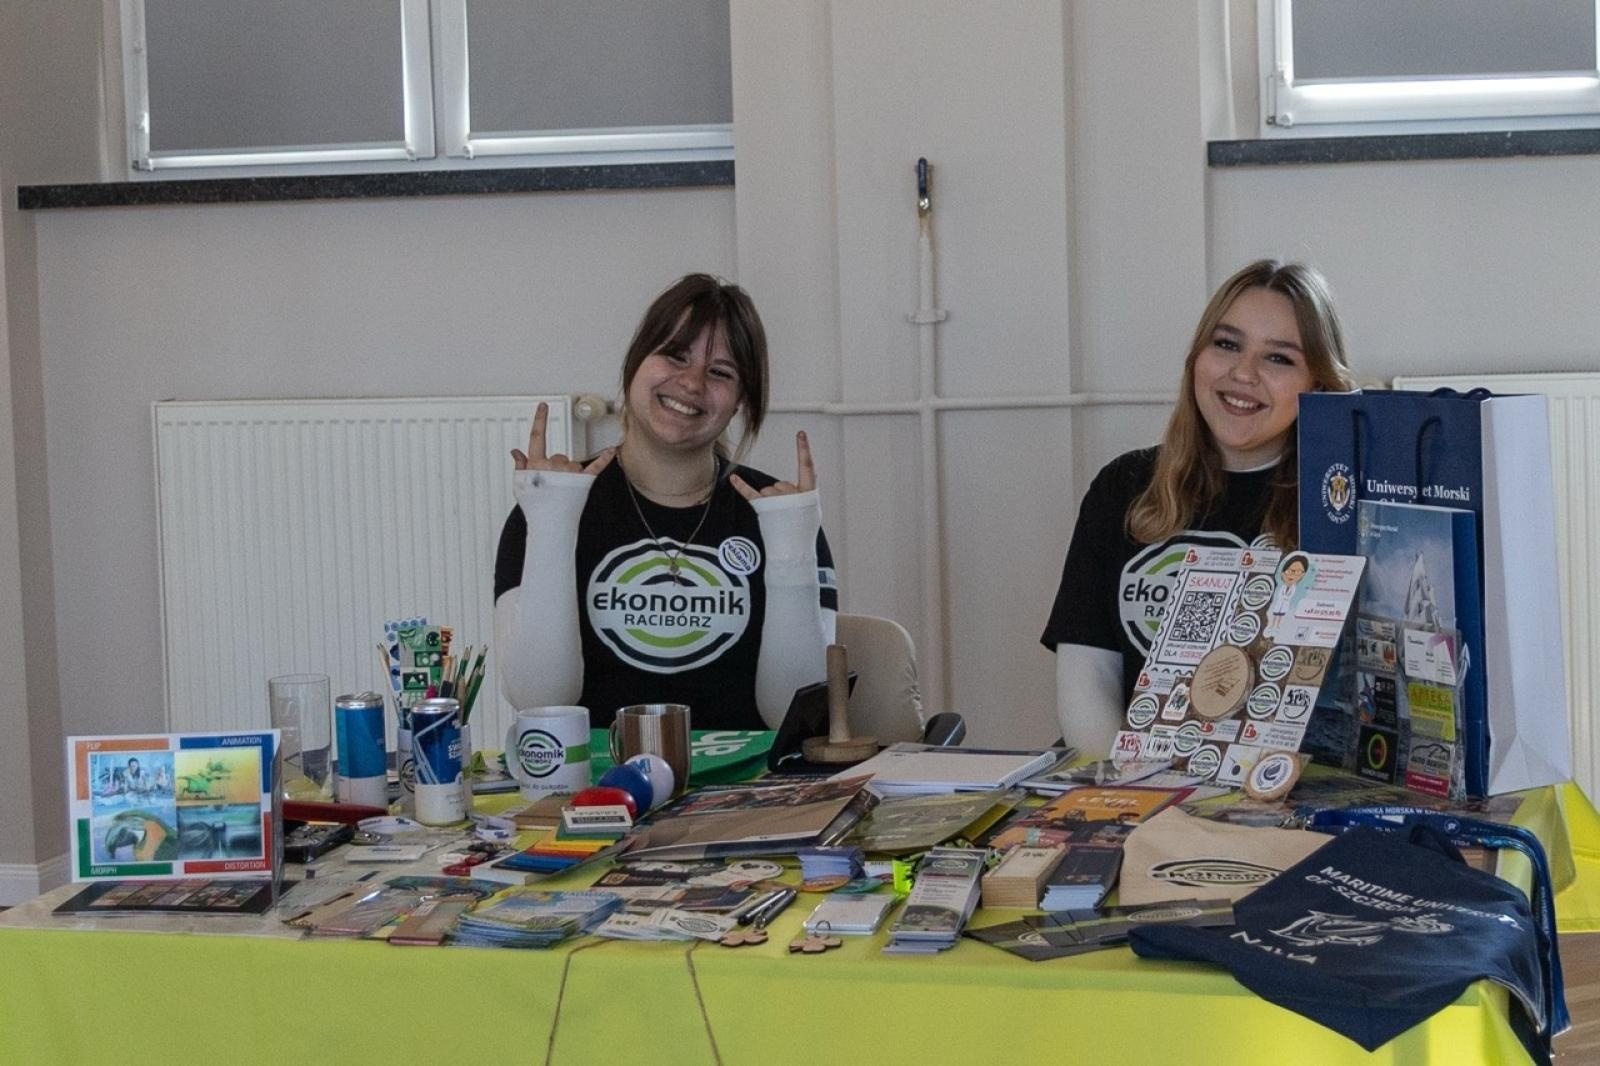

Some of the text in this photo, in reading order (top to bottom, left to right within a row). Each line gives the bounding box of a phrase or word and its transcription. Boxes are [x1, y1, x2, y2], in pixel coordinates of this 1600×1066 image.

[1367, 479, 1470, 501] Uniwersyet Morski
[1189, 576, 1233, 590] SKANUJ
[593, 587, 745, 615] ekonomik
[624, 613, 712, 628] RACIBÓRZ
[222, 736, 262, 746] ANIMATION
[90, 866, 117, 875] MORPH
[224, 862, 266, 871] DISTORTION
[1304, 873, 1332, 886] OF
[1320, 865, 1413, 904] MARITIME
